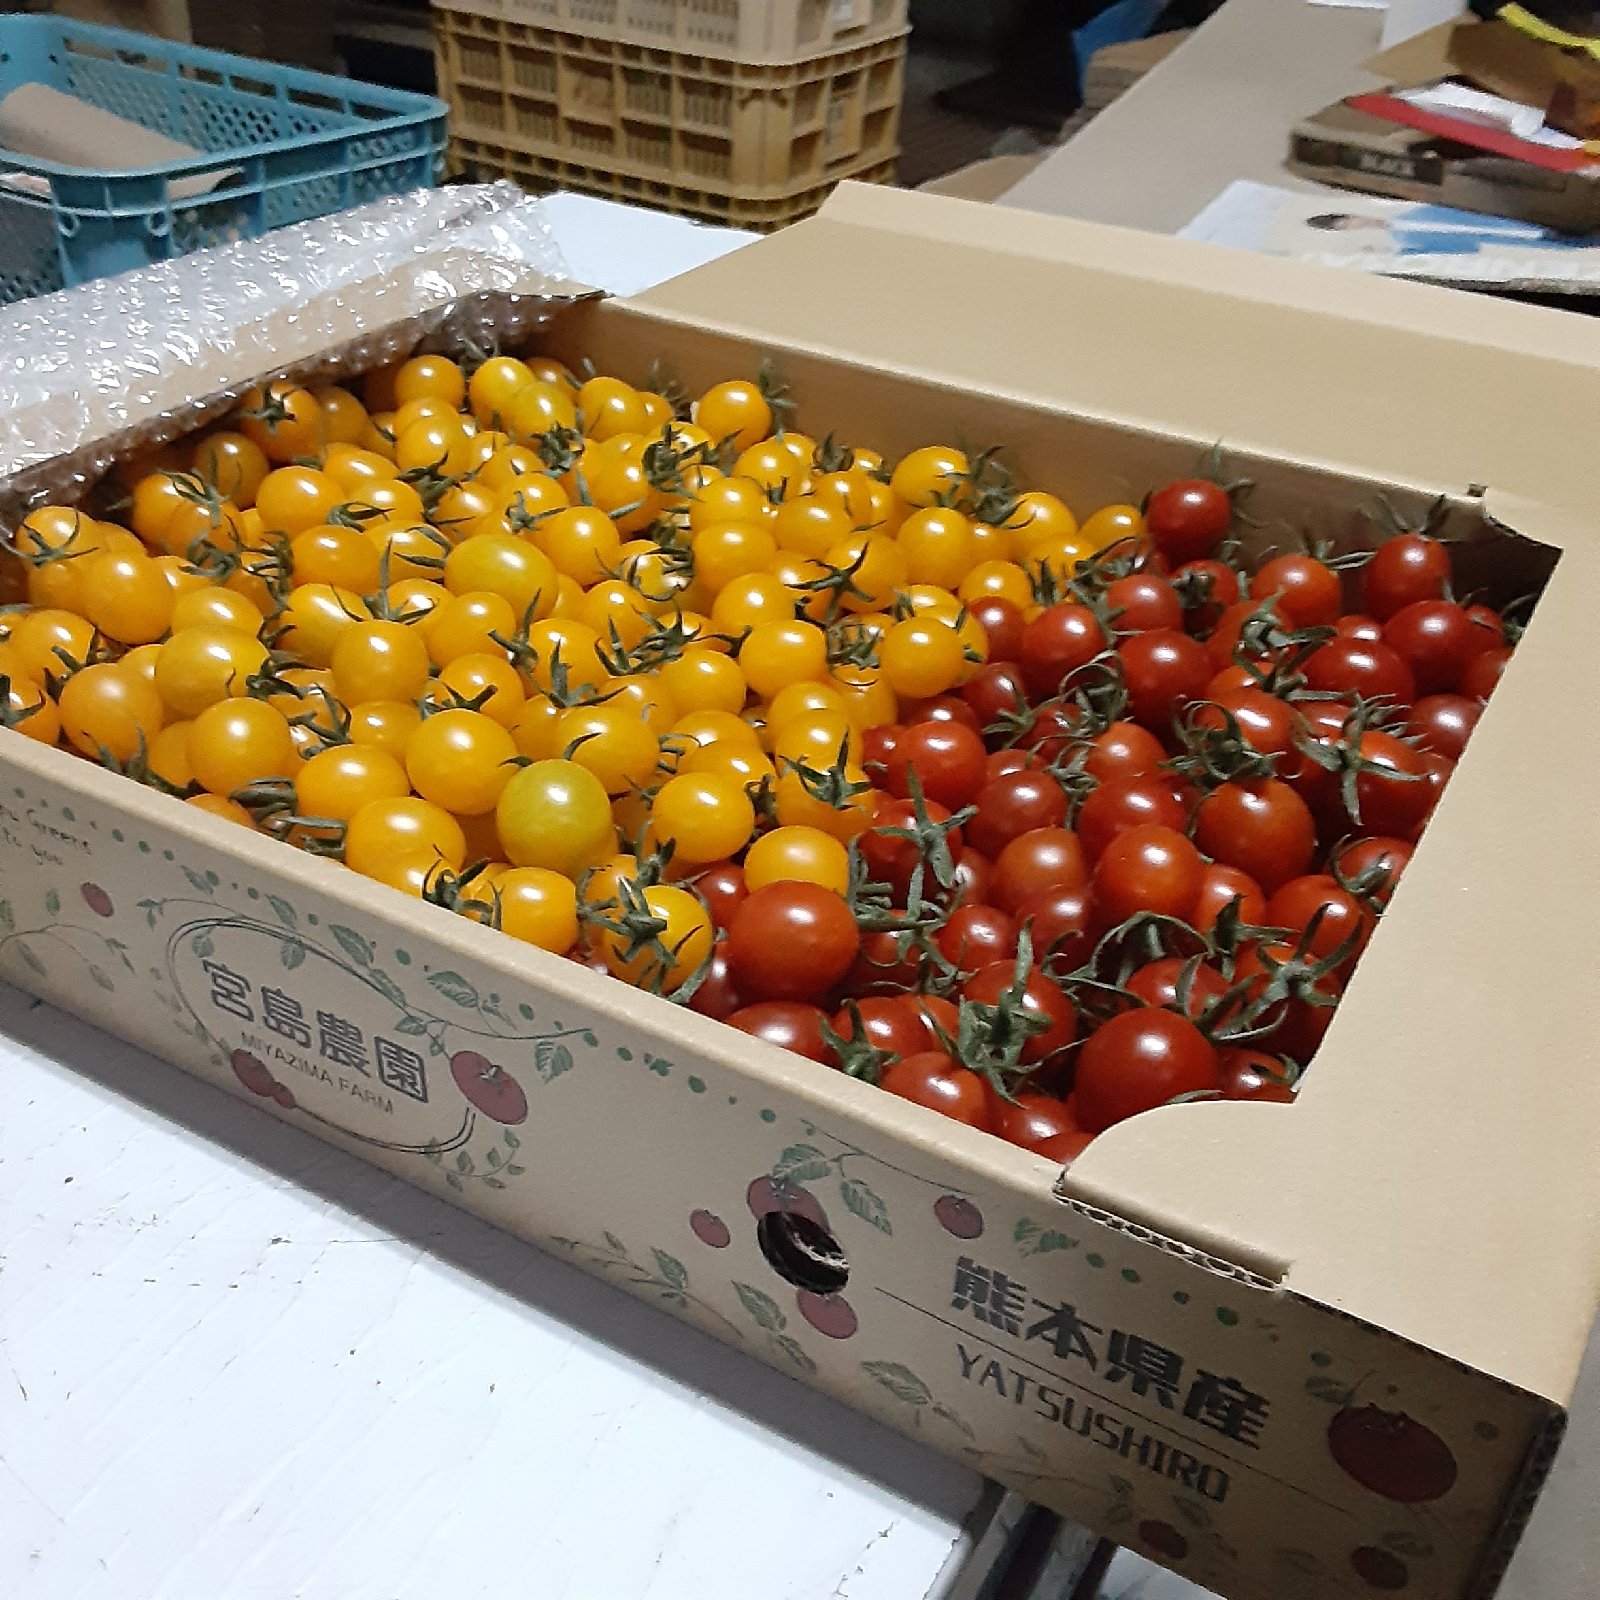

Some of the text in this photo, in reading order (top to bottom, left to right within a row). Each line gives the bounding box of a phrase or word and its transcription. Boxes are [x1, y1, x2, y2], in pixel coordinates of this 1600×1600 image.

[202, 958, 428, 1103] 宮島農園
[240, 1030, 394, 1115] MIYAZIMA FARM
[951, 1255, 1270, 1450] 熊本県産
[957, 1343, 1230, 1503] YATSUSHIRO
